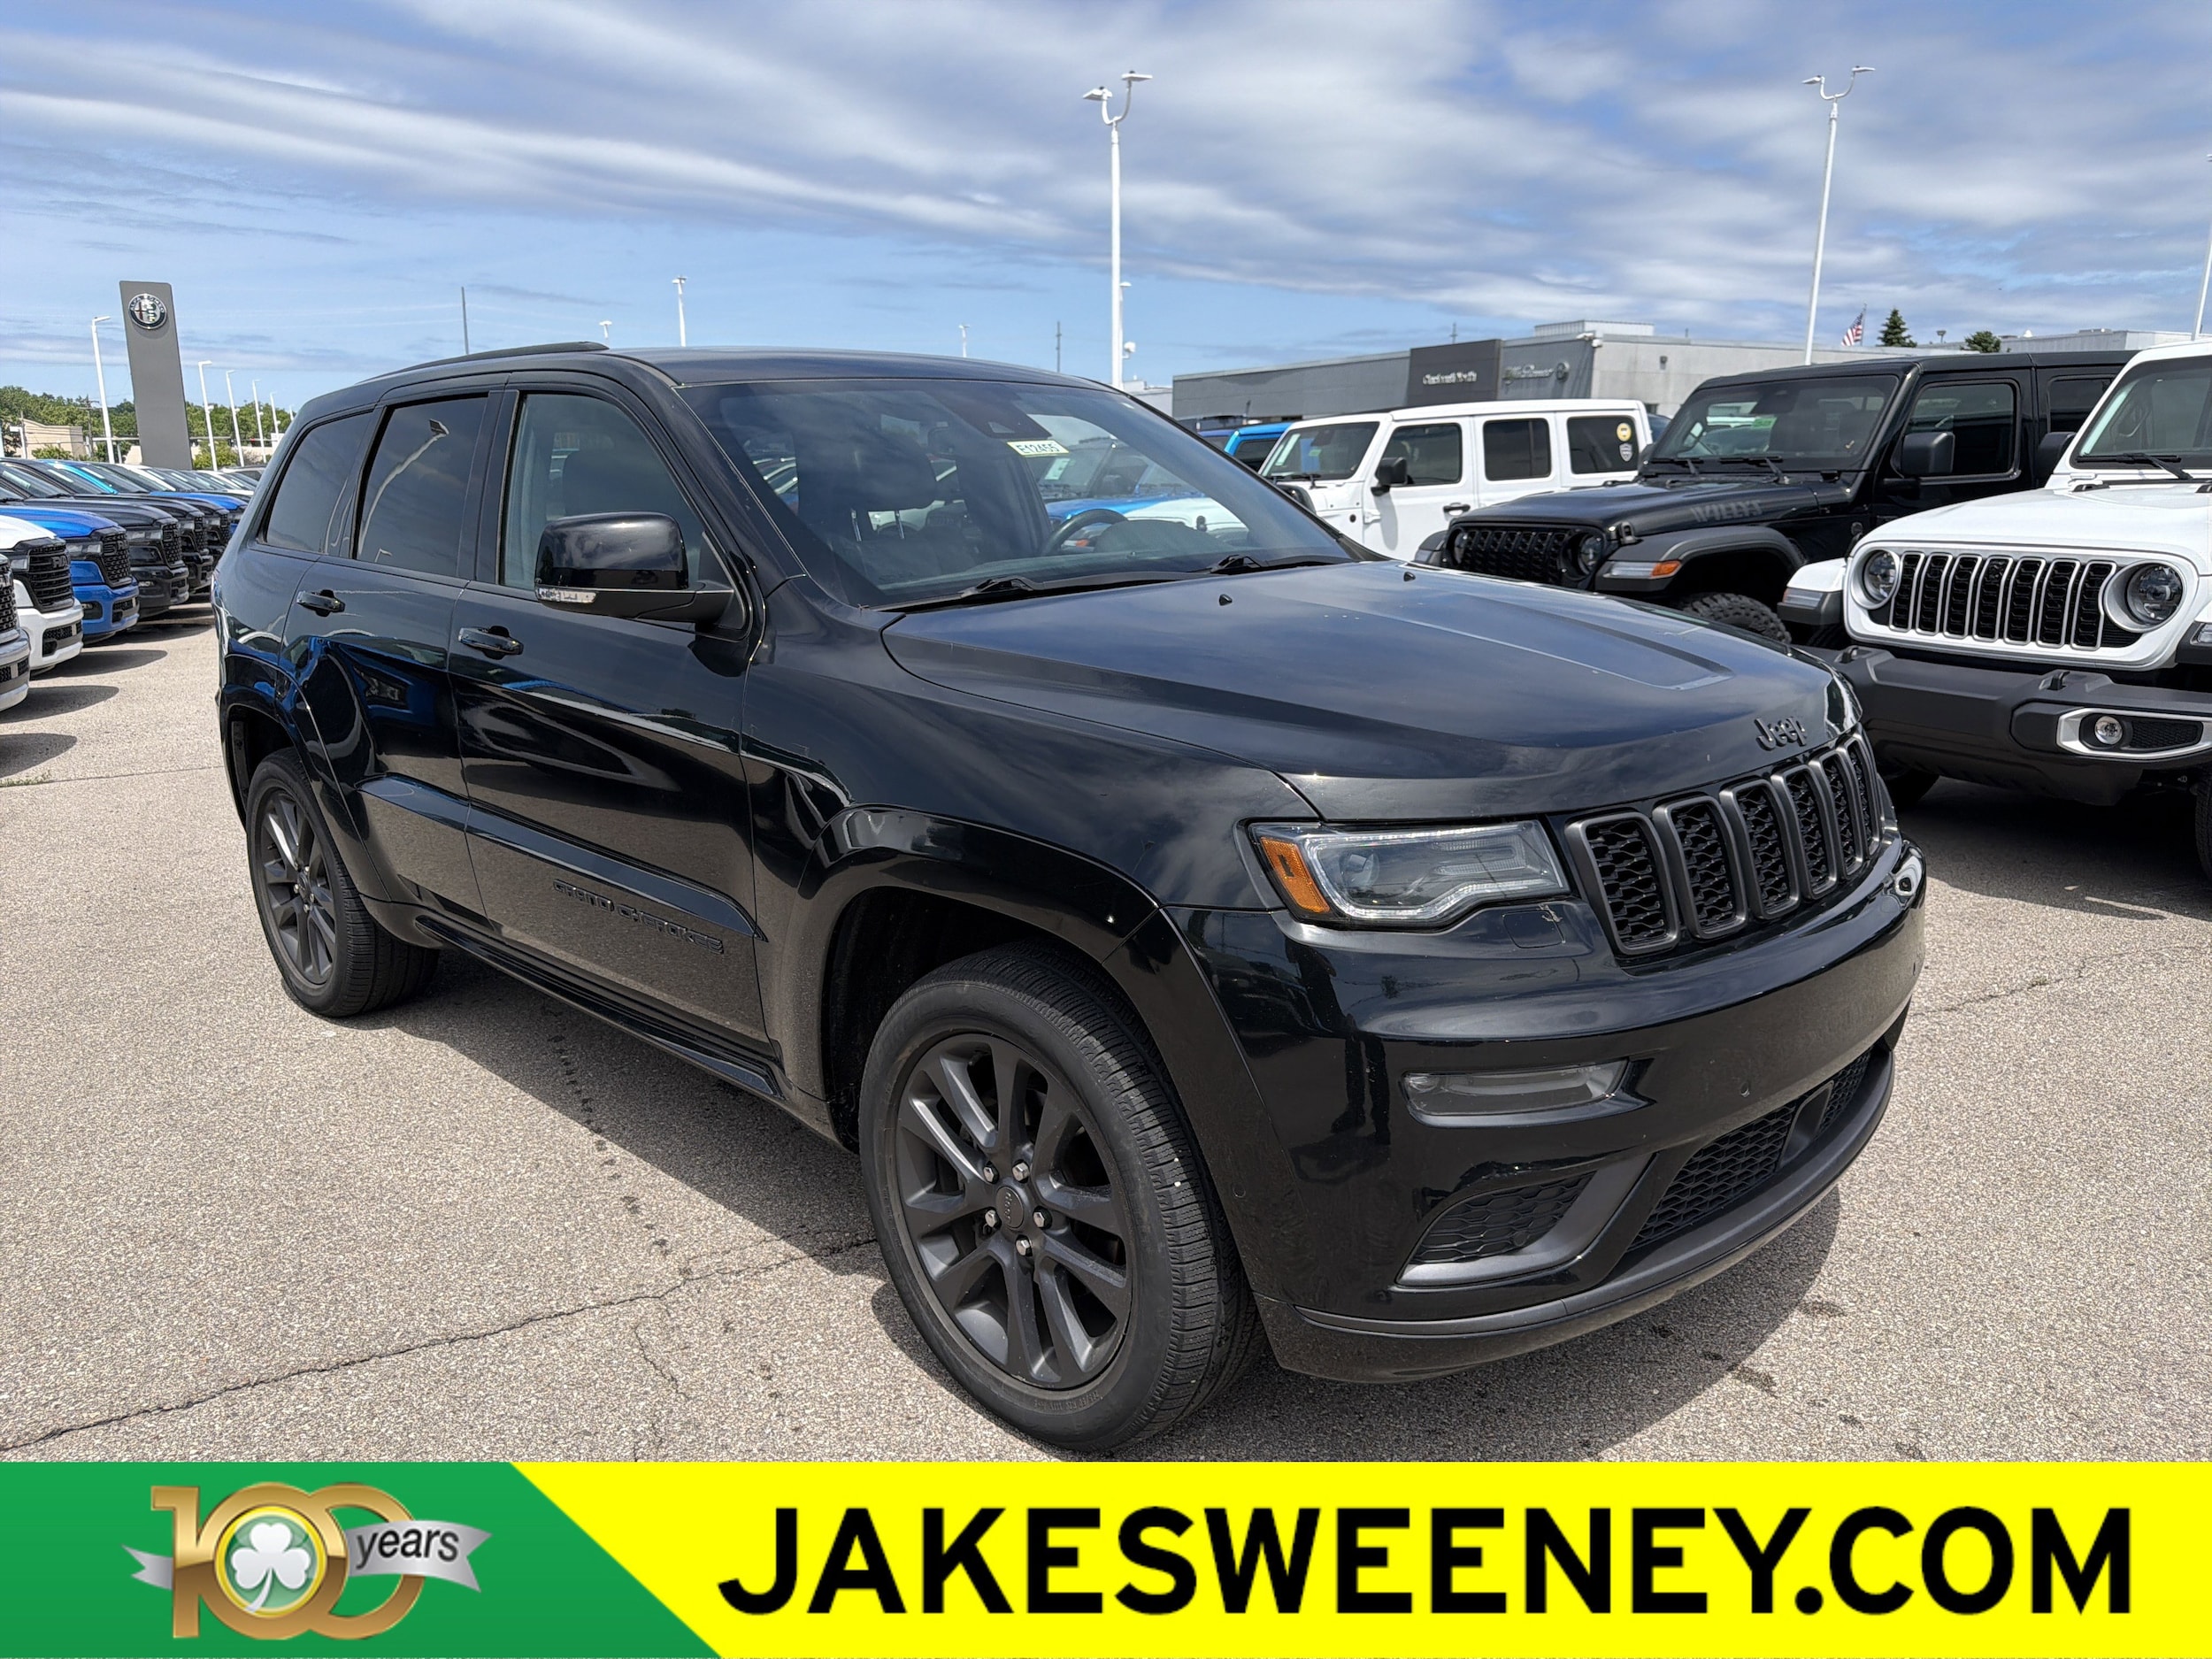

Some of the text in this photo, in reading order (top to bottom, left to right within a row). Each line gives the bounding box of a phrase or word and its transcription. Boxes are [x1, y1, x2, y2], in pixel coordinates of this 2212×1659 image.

[1754, 717, 1807, 751] Jeep
[553, 879, 725, 955] GRAND CHEROKEE
